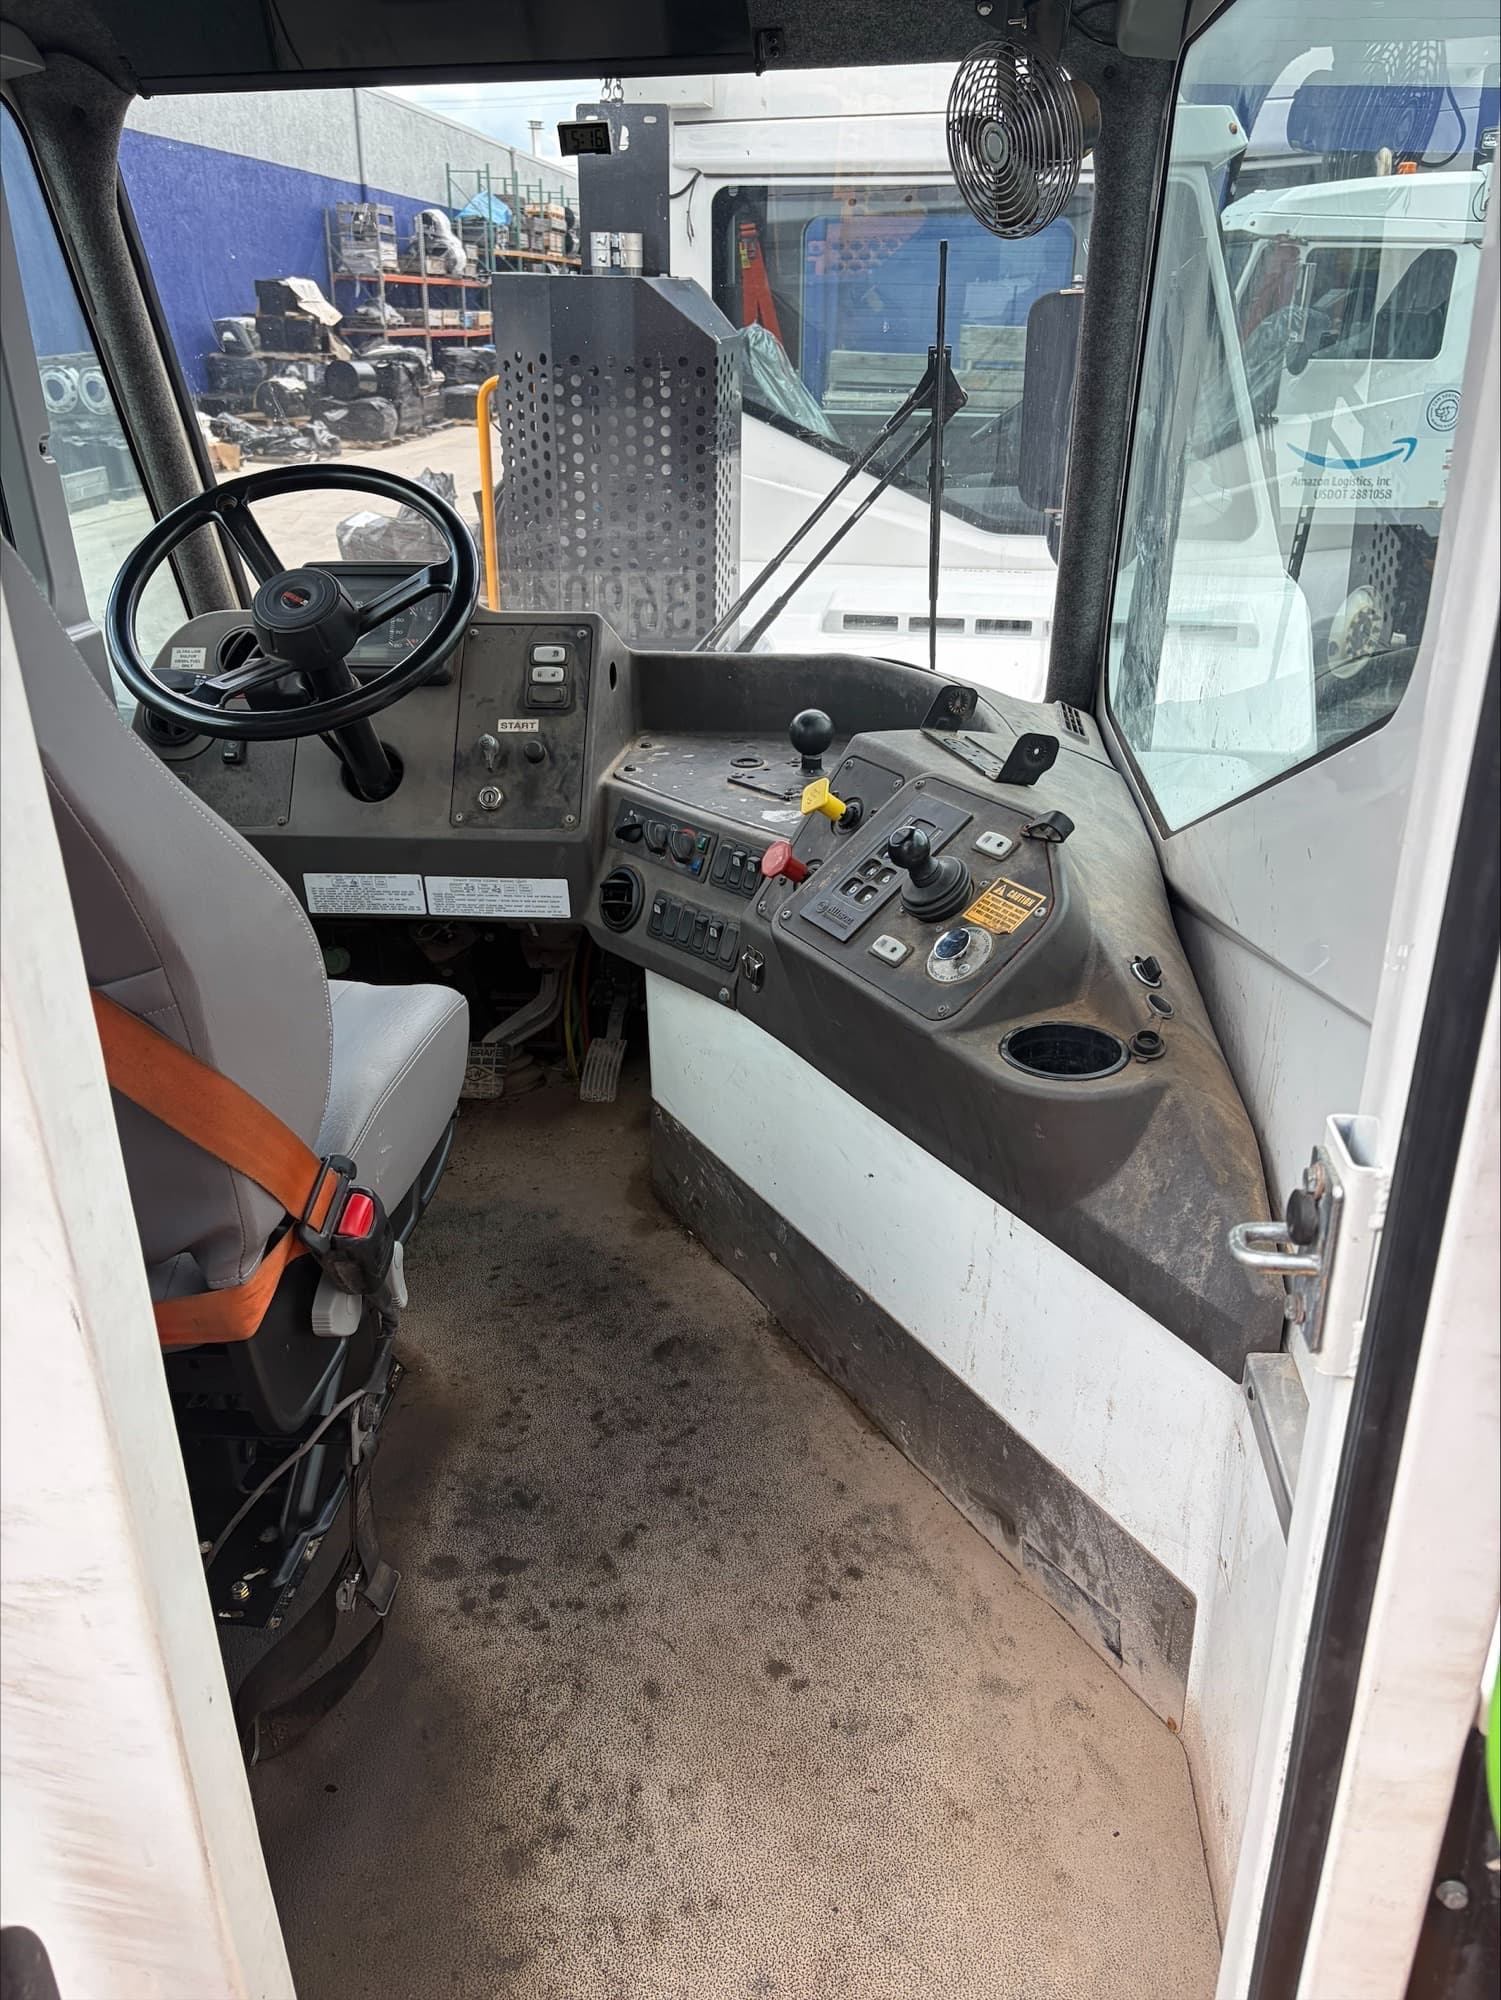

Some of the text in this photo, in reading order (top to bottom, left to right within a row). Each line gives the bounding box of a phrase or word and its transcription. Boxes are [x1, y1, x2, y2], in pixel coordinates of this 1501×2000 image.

[1291, 476, 1391, 489] Amazon Logistics, Inc
[1314, 489, 1392, 500] USDOT 2881058
[500, 721, 536, 730] START
[1007, 889, 1036, 907] CAUTION
